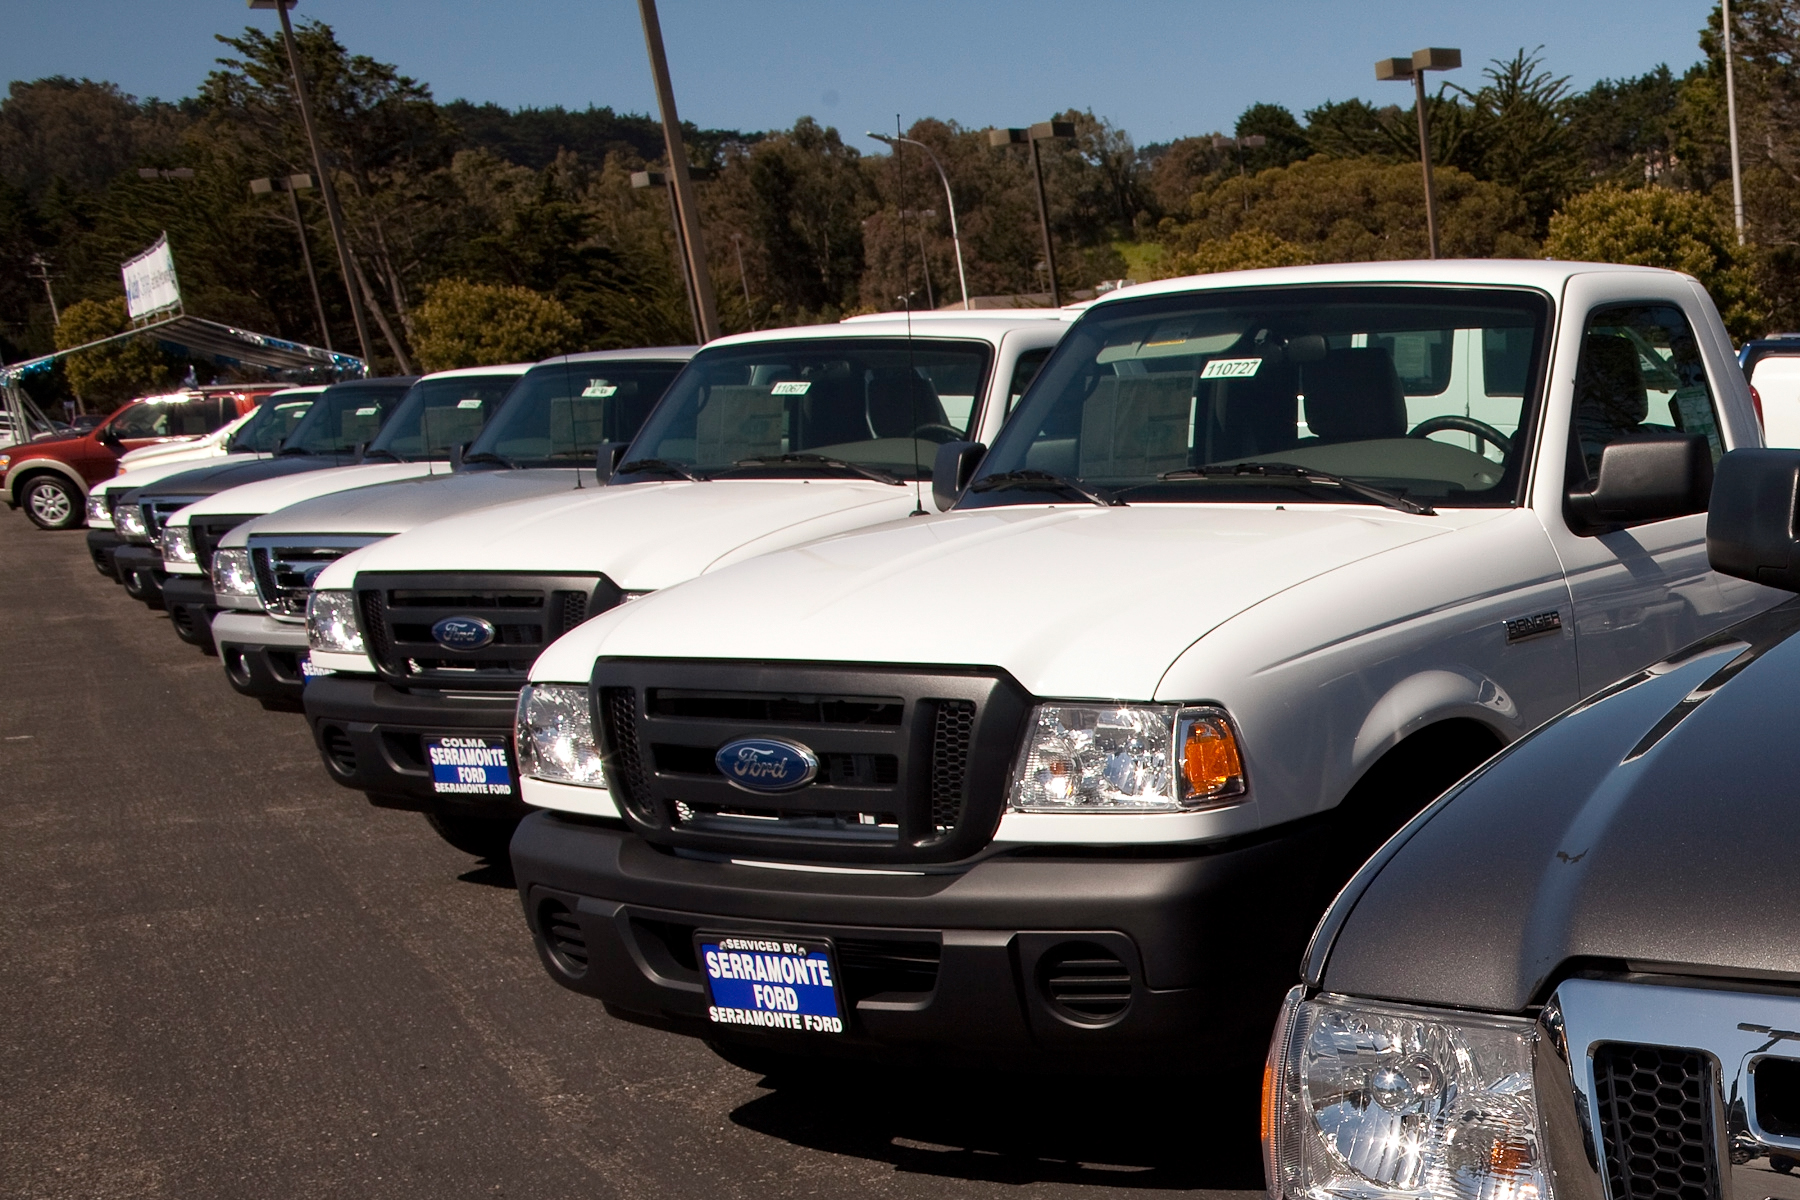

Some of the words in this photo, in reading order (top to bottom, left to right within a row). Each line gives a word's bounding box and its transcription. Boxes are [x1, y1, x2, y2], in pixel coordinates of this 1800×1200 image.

[1208, 361, 1258, 376] 110727
[443, 622, 476, 641] Ford
[1507, 610, 1561, 637] RANGER
[441, 738, 487, 748] COLMA
[430, 747, 508, 767] SERRAMONTE
[734, 747, 788, 779] Ford
[458, 767, 487, 784] FORD
[434, 782, 488, 794] SERRAMONTE
[490, 784, 511, 795] FORD
[726, 939, 782, 952] SERVICED
[784, 943, 799, 954] BY
[706, 950, 832, 987] SERRAMONTE
[753, 982, 799, 1011] FORD
[709, 1006, 802, 1030] SERRAMONTE
[804, 1014, 843, 1033] FORD
